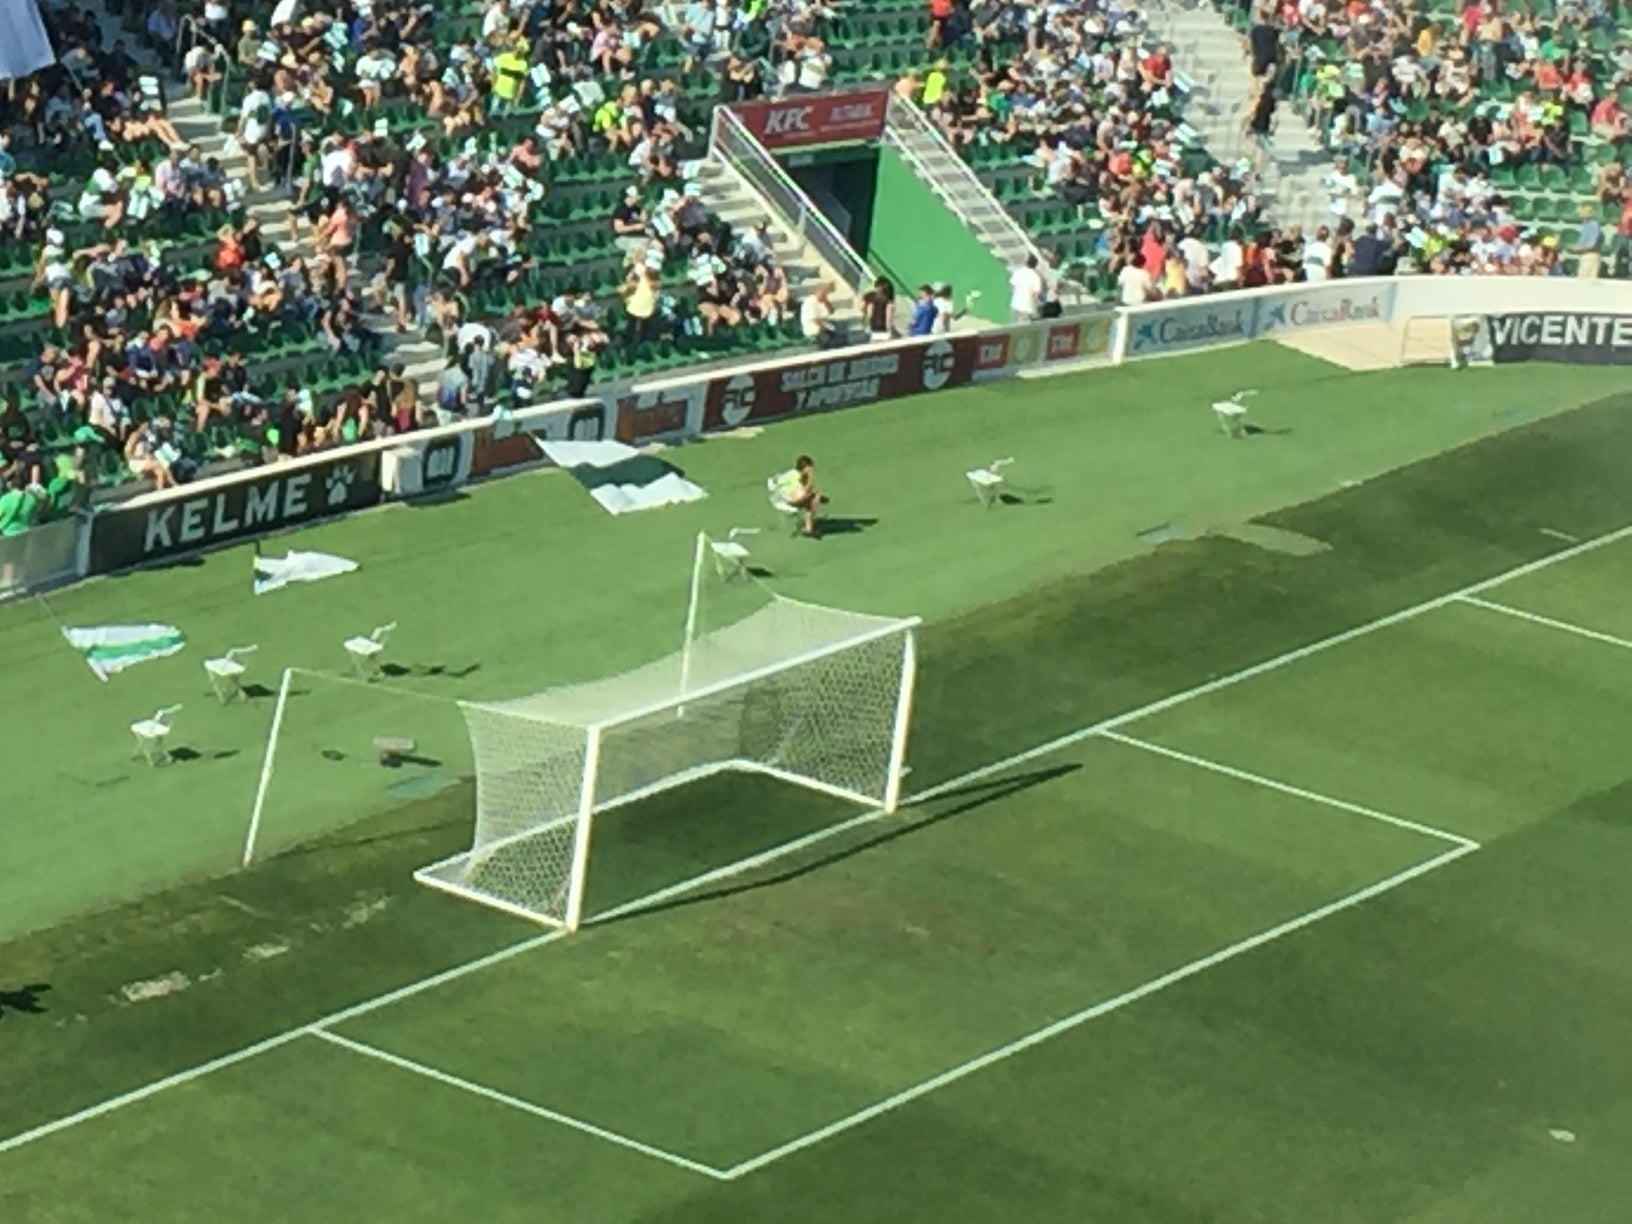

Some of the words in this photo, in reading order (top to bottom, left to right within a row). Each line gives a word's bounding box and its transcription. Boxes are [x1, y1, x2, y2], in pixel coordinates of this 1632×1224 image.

[763, 107, 810, 134] KFC
[1491, 314, 1632, 346] VICENTE
[144, 473, 311, 552] KELME
